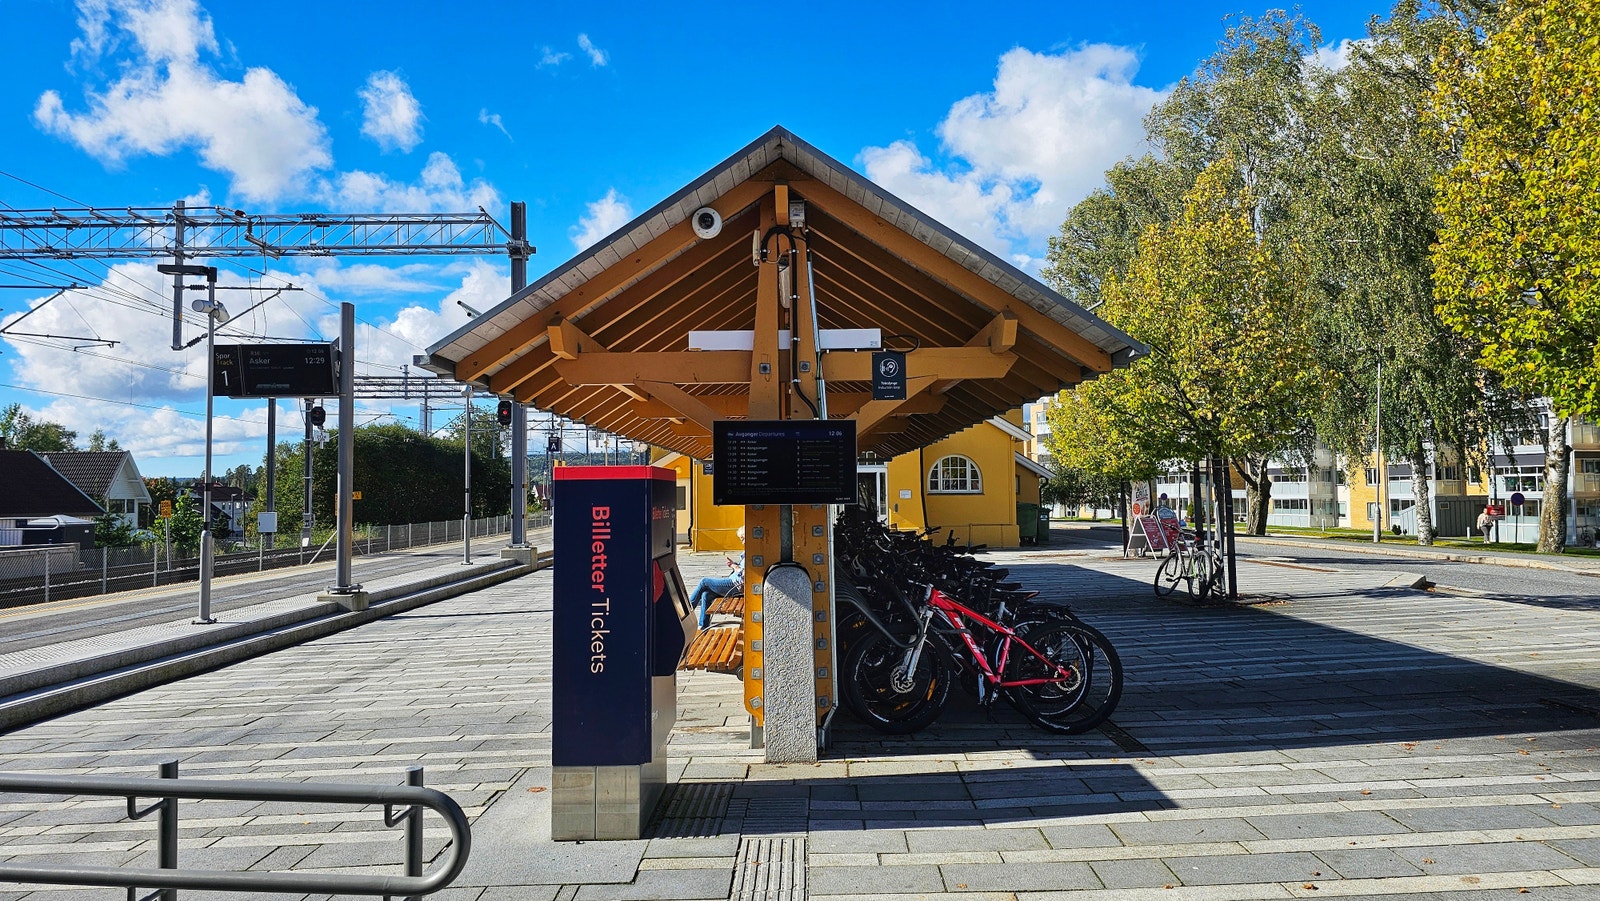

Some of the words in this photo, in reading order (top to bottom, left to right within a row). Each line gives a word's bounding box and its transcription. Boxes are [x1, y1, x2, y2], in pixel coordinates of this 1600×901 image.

[215, 352, 231, 360] Spor
[249, 357, 270, 365] Asker
[304, 357, 325, 365] 12:29
[221, 370, 229, 387] 1
[591, 506, 611, 592] Billetter
[590, 598, 610, 674] Tickets
